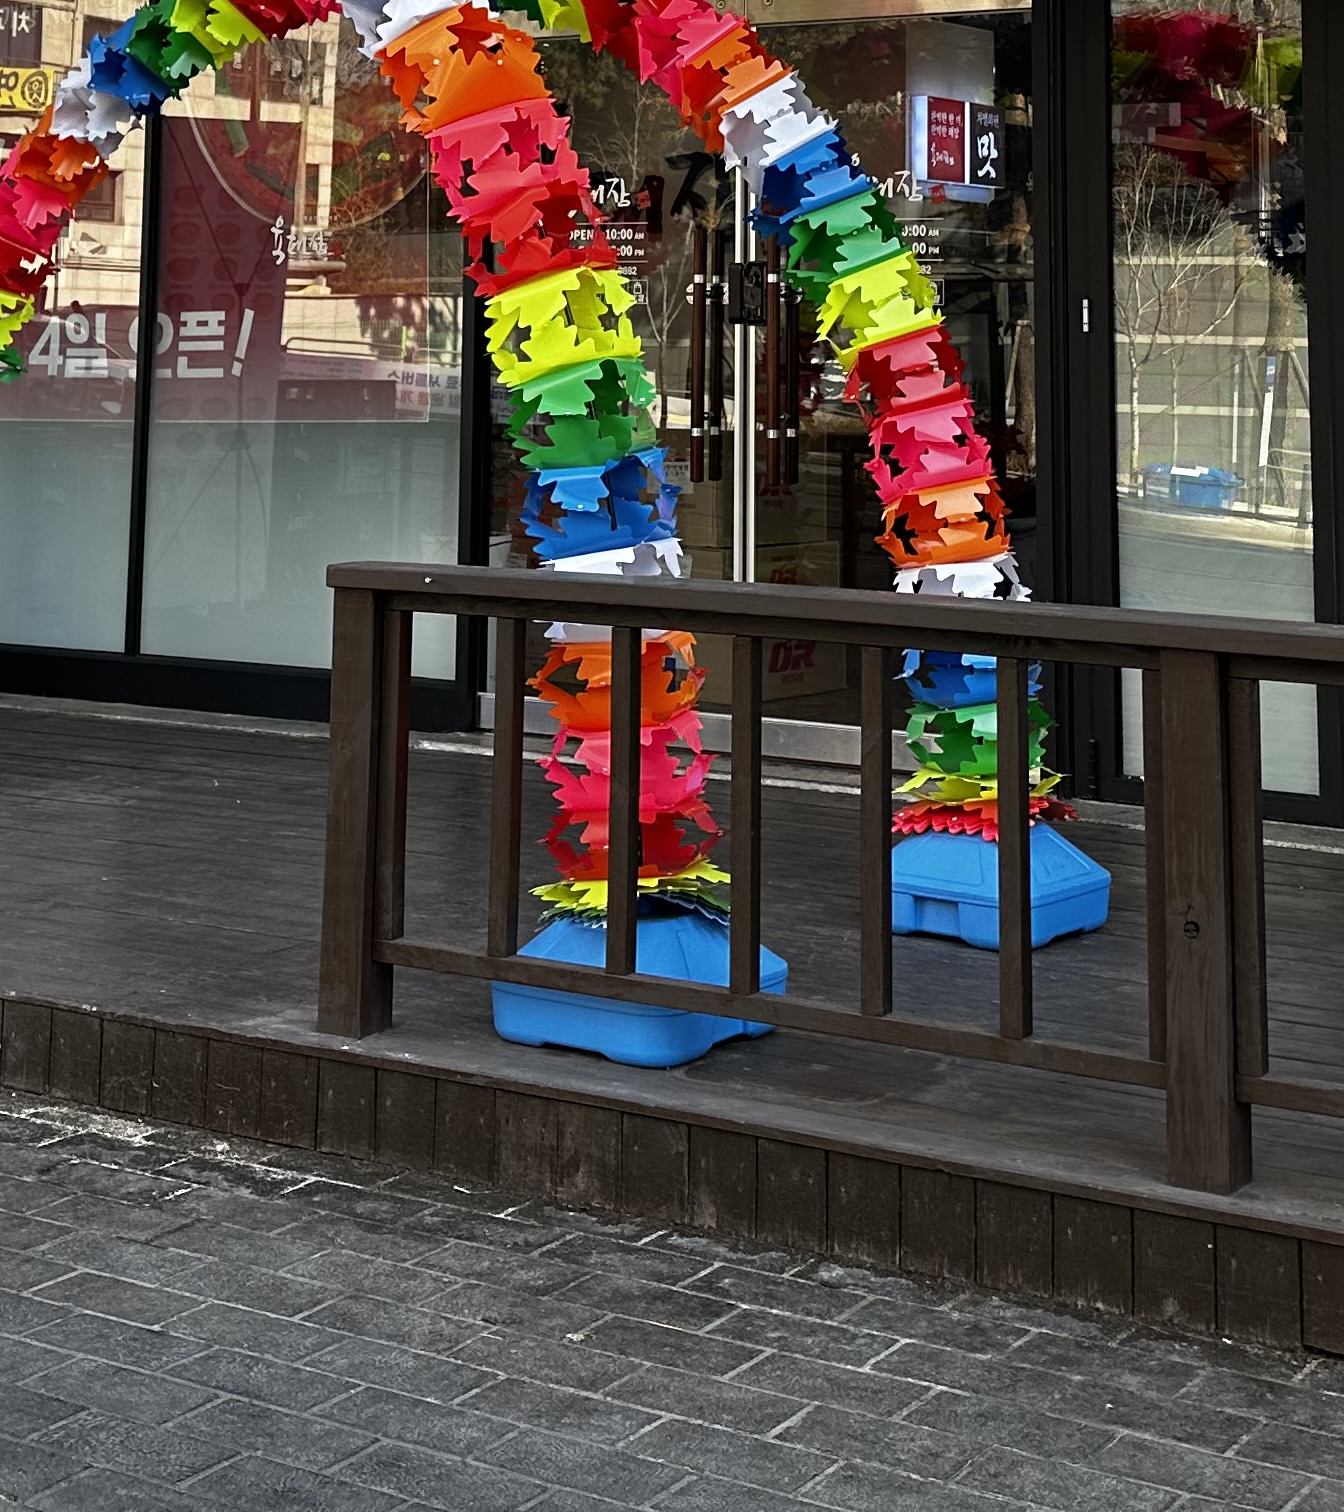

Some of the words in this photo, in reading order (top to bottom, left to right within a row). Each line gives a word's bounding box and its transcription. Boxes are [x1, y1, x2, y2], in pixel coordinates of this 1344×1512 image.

[977, 131, 999, 179] 맛
[270, 216, 329, 265] 육대장
[605, 229, 634, 240] 10:00
[128, 308, 255, 378] 오픈!
